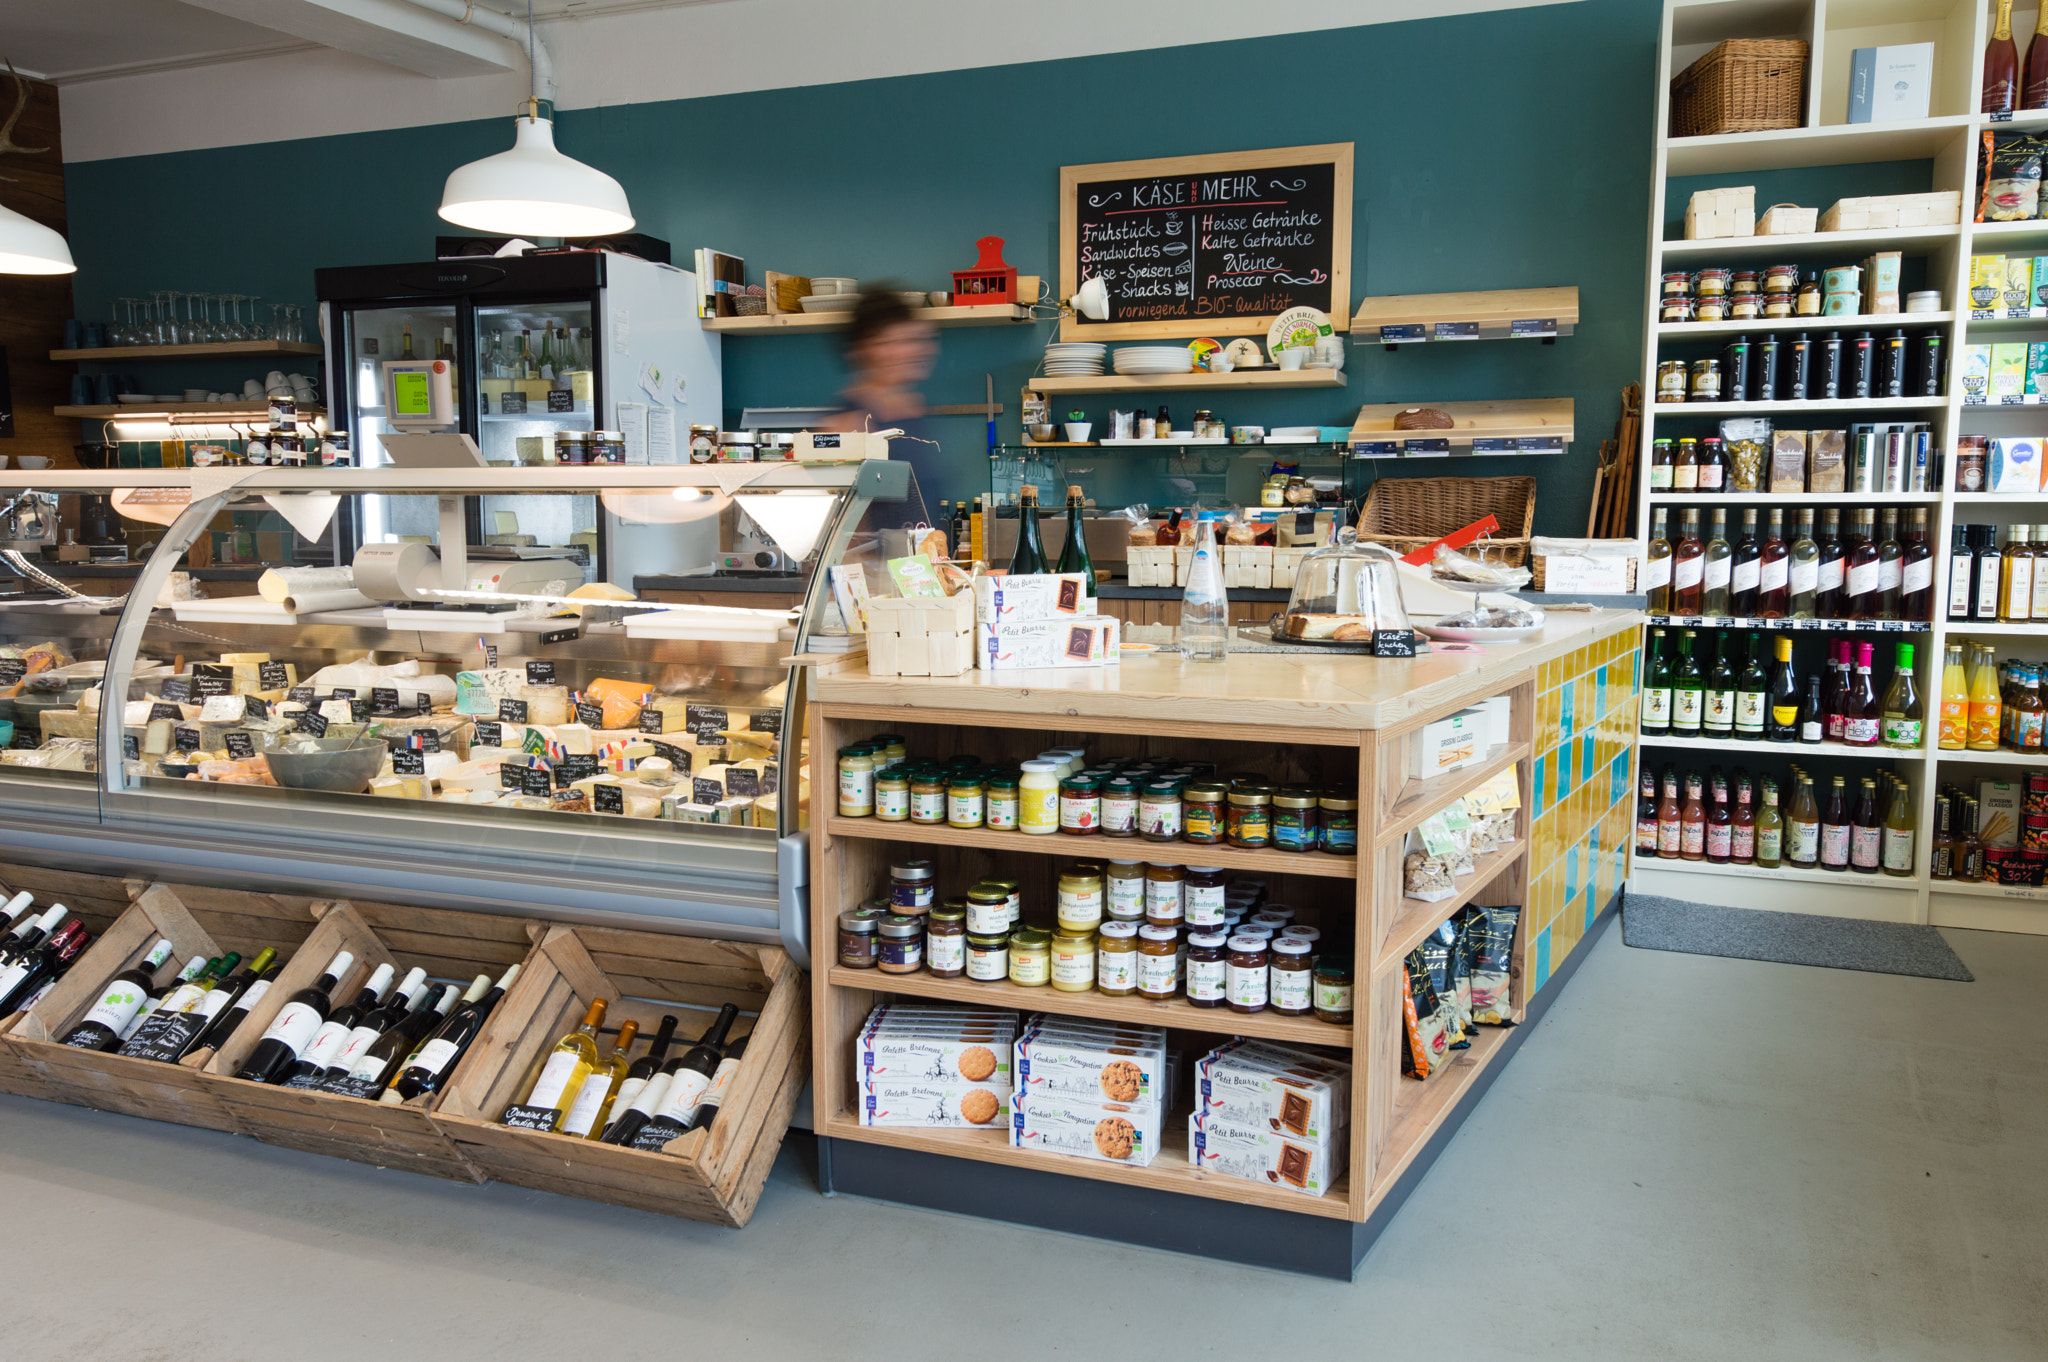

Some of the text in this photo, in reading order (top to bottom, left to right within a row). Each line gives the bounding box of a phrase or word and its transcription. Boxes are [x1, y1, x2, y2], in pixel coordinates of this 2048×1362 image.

[1132, 181, 1185, 207] KÄSE
[1202, 176, 1261, 201] MEHR
[1202, 209, 1321, 232] Heisse Getränke
[1082, 218, 1161, 243] Frühstück
[1201, 231, 1315, 251] Kalte Getränke
[1081, 241, 1161, 263] Sandwiches
[1222, 253, 1284, 273] Weine
[1207, 274, 1268, 290] Prosecco
[1117, 299, 1189, 321] vorwiegend
[1005, 578, 1019, 589] Petit
[1022, 578, 1041, 587] Beurre
[1002, 625, 1019, 636] Petit
[1022, 624, 1046, 634] Beurre
[2003, 870, 2032, 882] 30%
[882, 1045, 906, 1054] Galette
[909, 1043, 940, 1054] Bretonne
[1033, 1052, 1057, 1064] Cookies
[1069, 1055, 1103, 1069] Nougatine
[1214, 1071, 1232, 1085] Petit
[1234, 1076, 1260, 1088] Beurre
[884, 1089, 909, 1097] Galette
[911, 1087, 943, 1097] Bretonne
[1028, 1106, 1051, 1119] Cookies
[1063, 1110, 1096, 1126] Nougatine
[1209, 1123, 1227, 1137] Petit
[1229, 1129, 1256, 1141] Beurre
